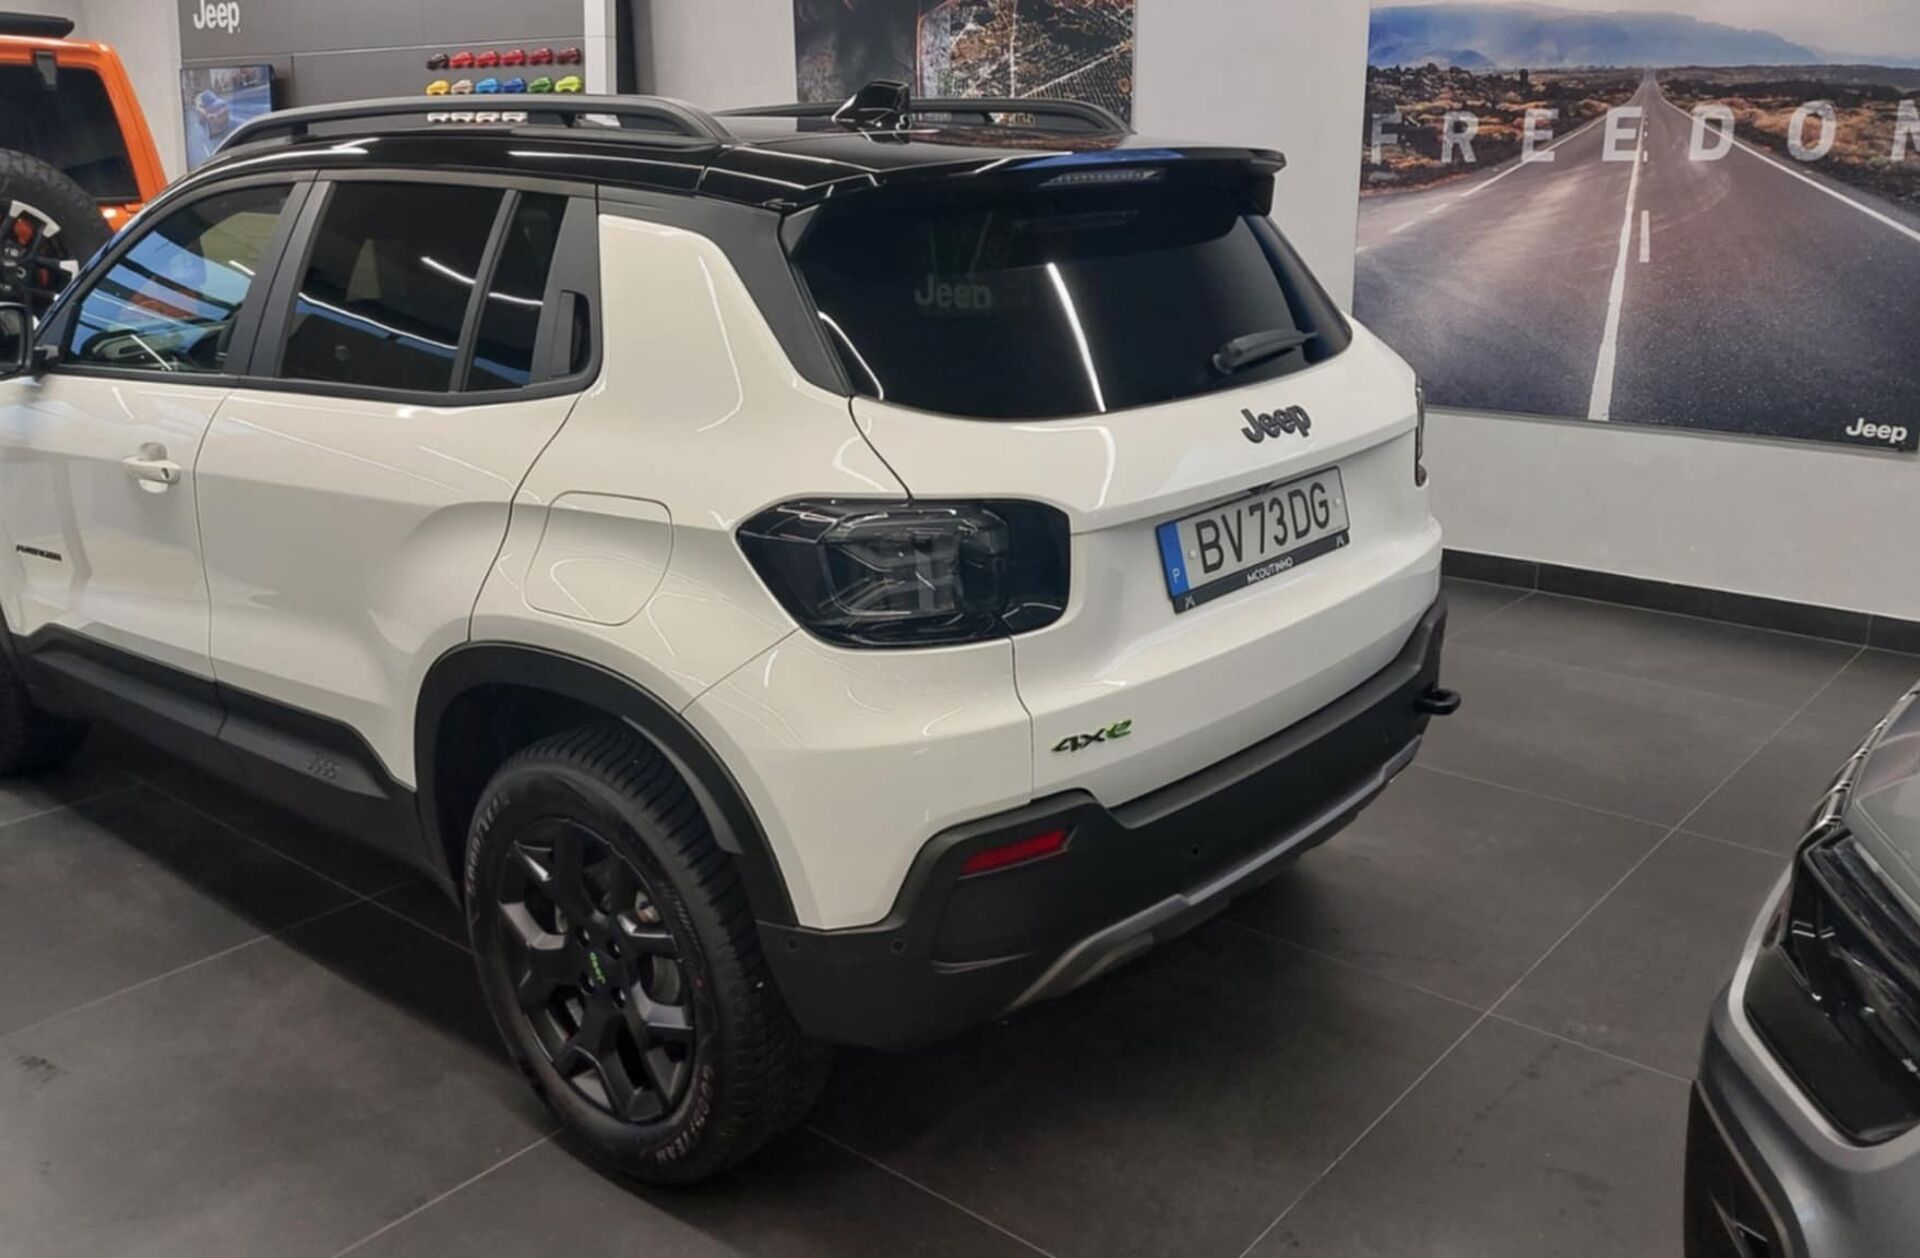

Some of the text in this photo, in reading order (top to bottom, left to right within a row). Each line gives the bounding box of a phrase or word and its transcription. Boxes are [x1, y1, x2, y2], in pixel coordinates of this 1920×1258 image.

[193, 0, 240, 35] Jeep
[1241, 404, 1312, 444] Jeep
[1845, 417, 1908, 444] Jeep
[1172, 568, 1180, 584] P
